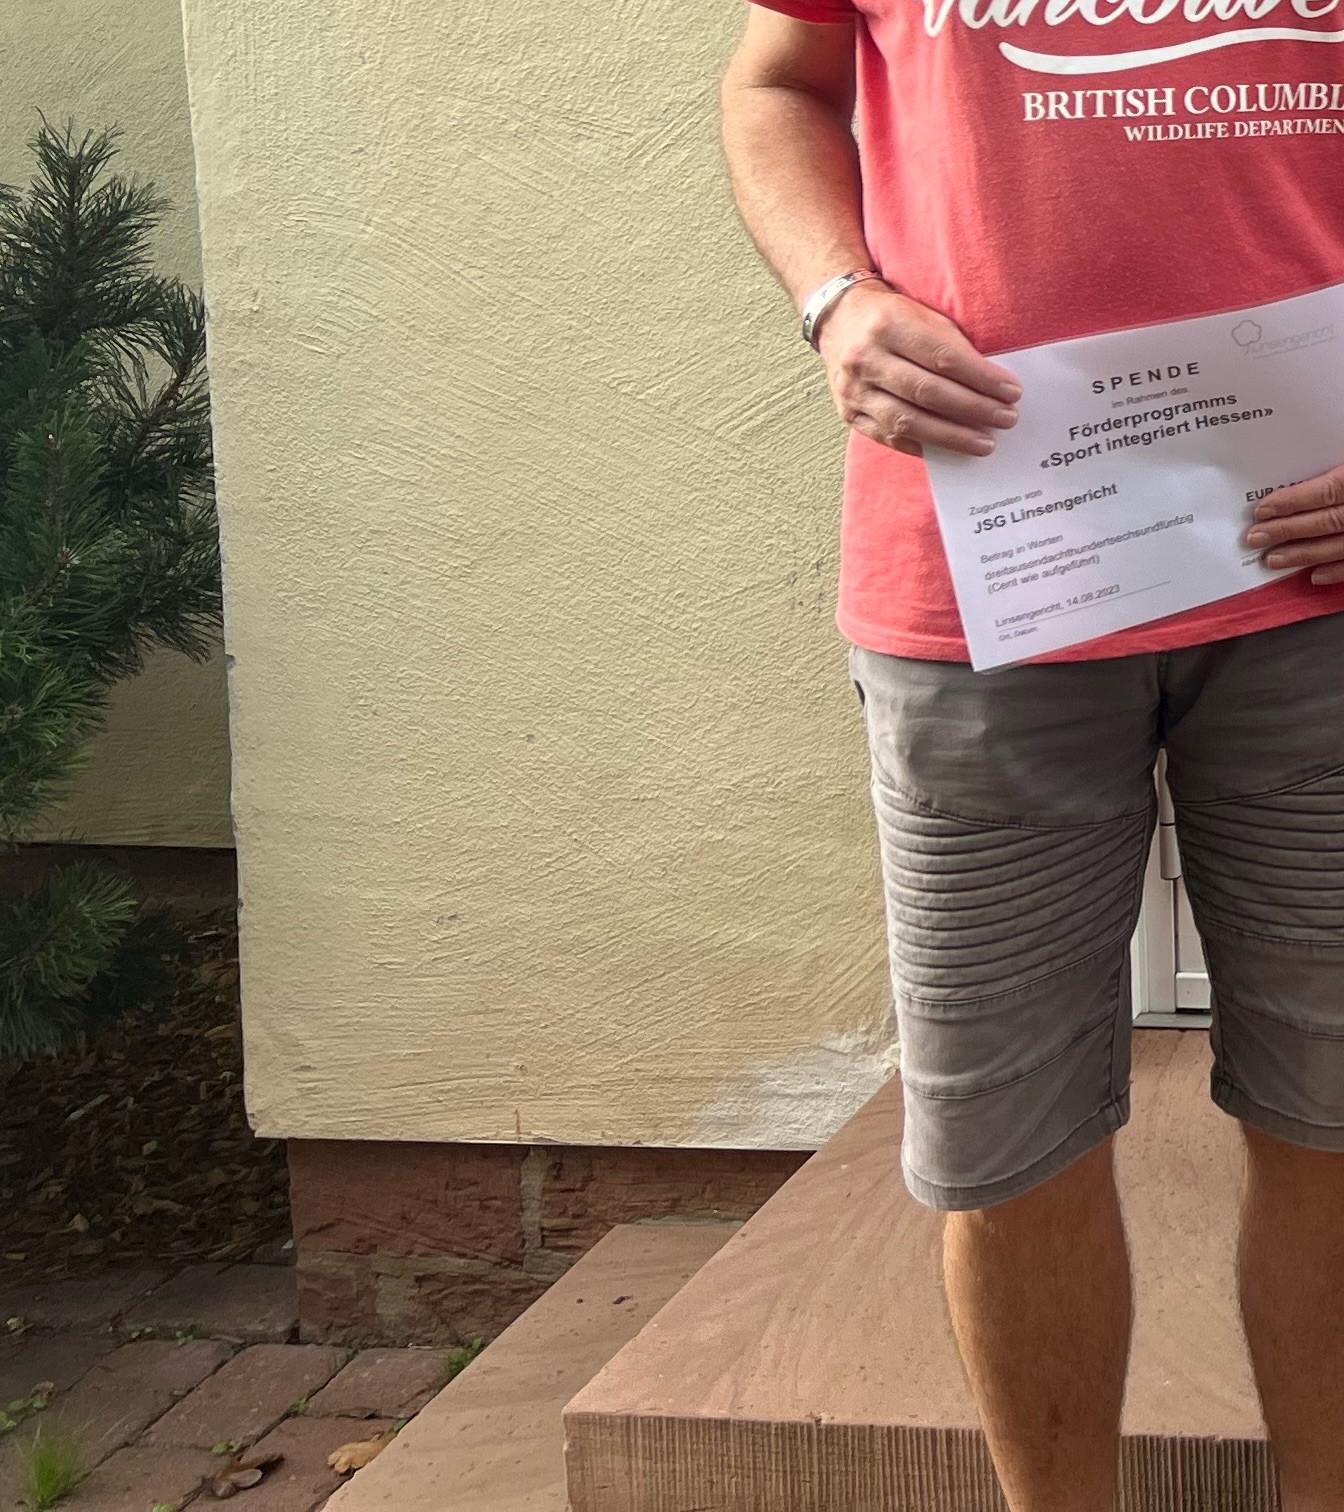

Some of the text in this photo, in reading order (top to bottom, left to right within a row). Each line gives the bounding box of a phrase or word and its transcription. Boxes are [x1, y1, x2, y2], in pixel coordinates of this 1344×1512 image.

[1023, 87, 1176, 121] BRITISH
[1125, 122, 1229, 142] WILDLIFE
[1092, 362, 1201, 395] SPENDE
[1126, 391, 1168, 407] Rahmen
[1069, 393, 1238, 442] Förderprogramms
[1040, 406, 1274, 471] «Sport integriert Hessen»
[973, 483, 1118, 535] JSG Linsengericht
